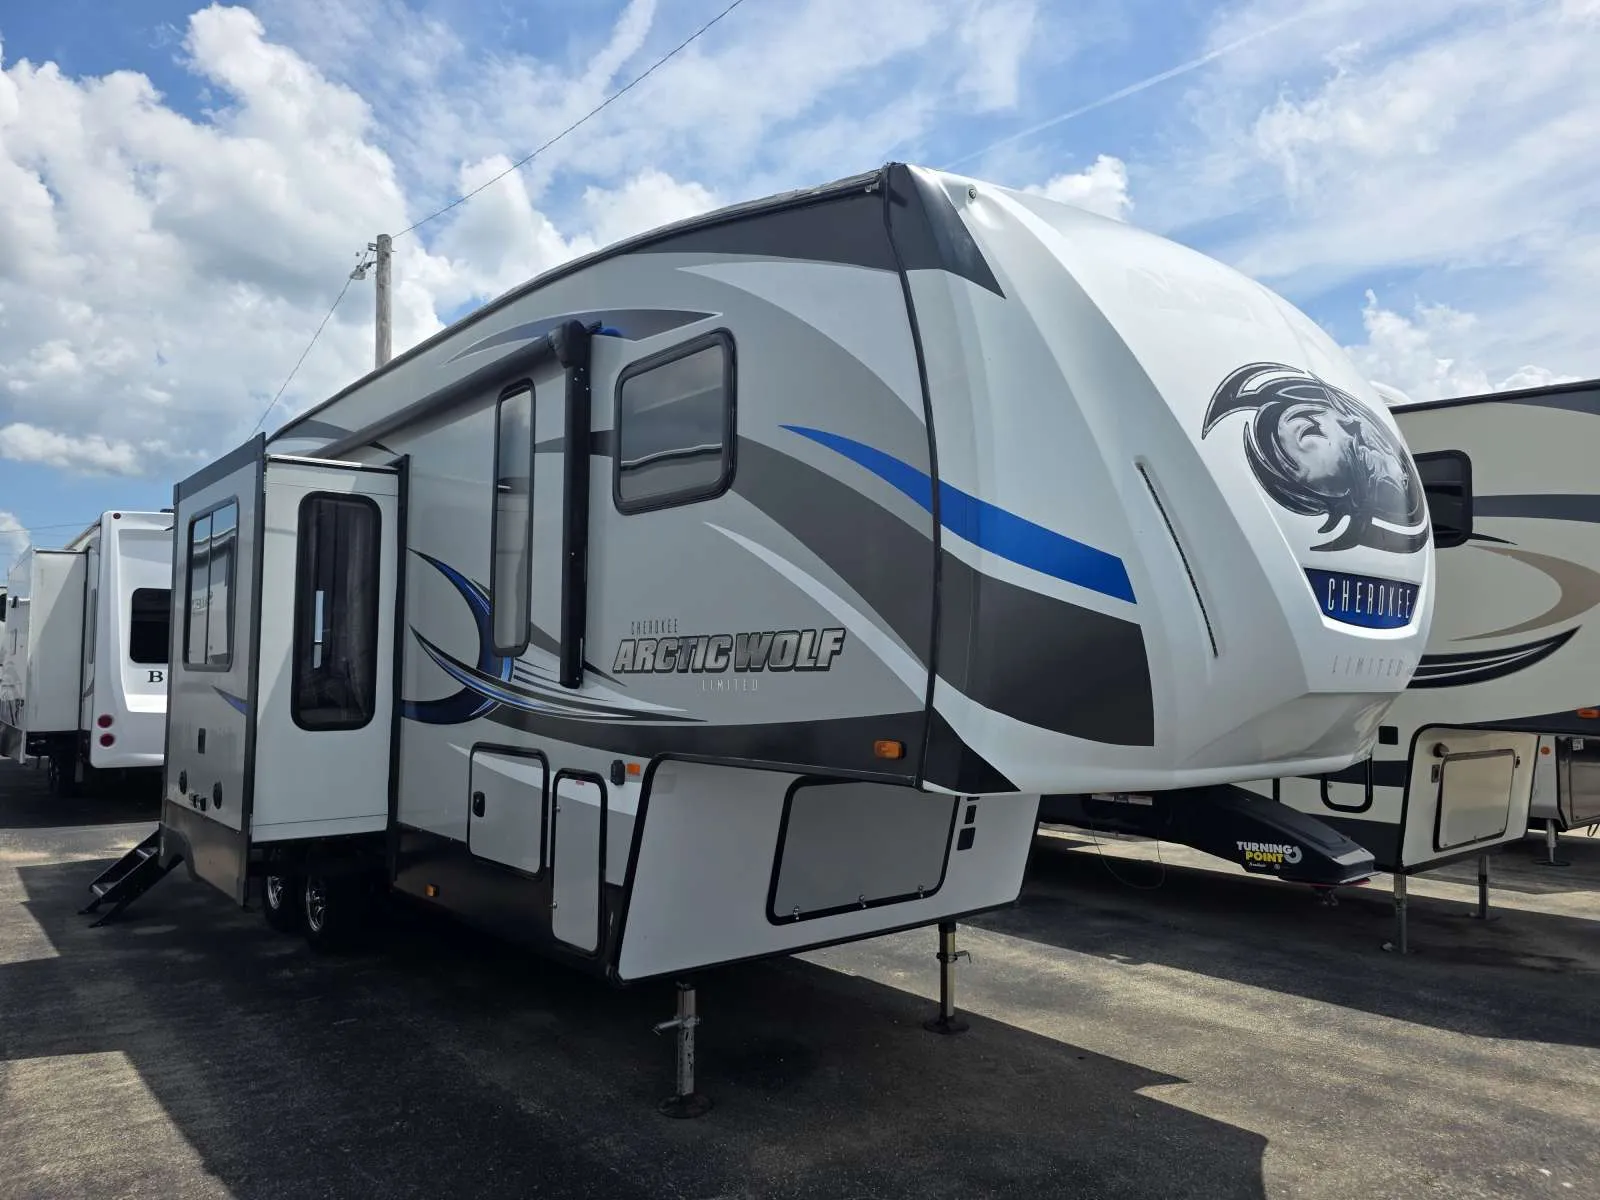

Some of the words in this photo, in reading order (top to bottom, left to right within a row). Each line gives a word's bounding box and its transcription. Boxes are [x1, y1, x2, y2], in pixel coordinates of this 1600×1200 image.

[1327, 577, 1411, 619] CHEROKEE
[631, 618, 678, 635] CHEROKEE
[612, 634, 733, 674] ARCTIC
[733, 627, 846, 672] WOLF
[1332, 655, 1404, 677] LIMITED
[702, 678, 759, 691] LIMITED
[1236, 840, 1293, 855] TURNING
[1245, 851, 1284, 863] POINT
